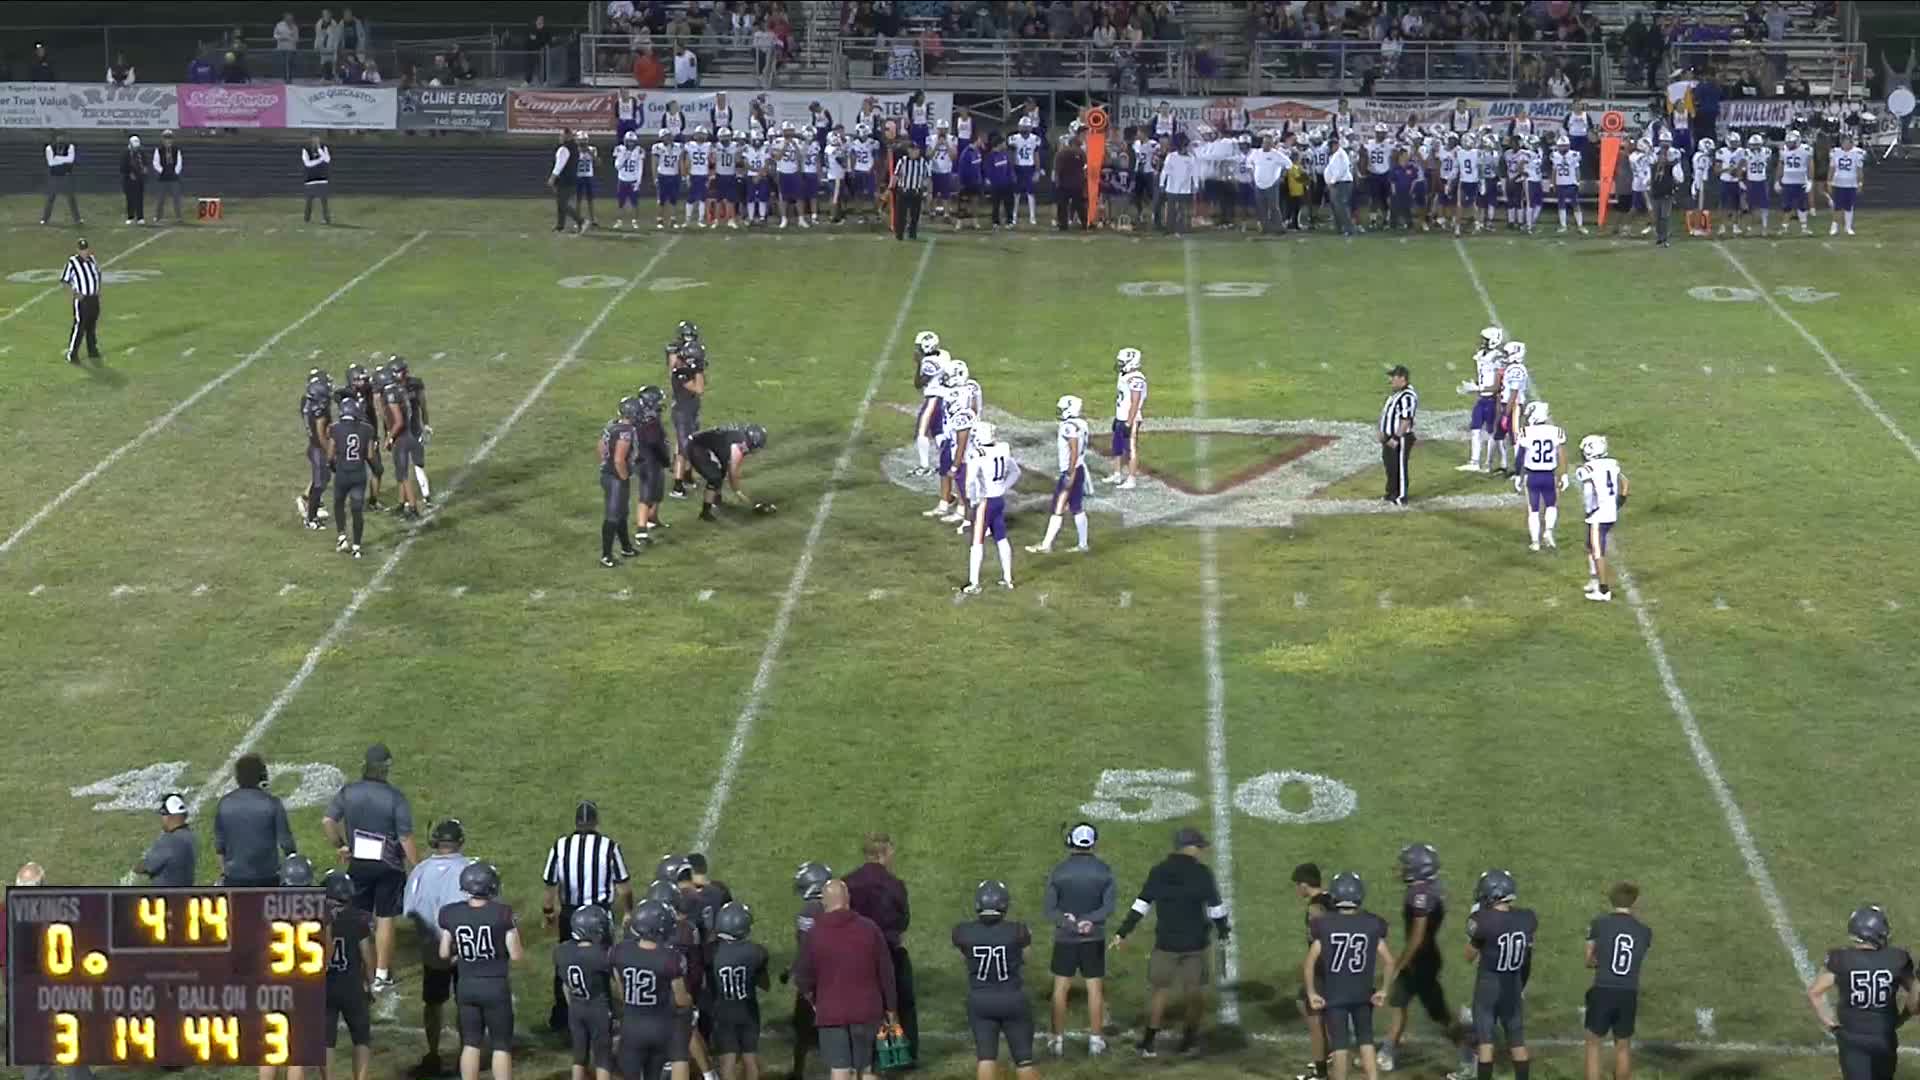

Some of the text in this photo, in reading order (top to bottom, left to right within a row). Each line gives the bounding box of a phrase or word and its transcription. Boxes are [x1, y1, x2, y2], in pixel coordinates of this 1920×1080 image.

[13, 96, 36, 105] True
[39, 95, 69, 106] Value
[421, 91, 505, 106] CLINE ENERGY
[1488, 102, 1524, 116] AUTO
[346, 433, 361, 461] 2
[1531, 439, 1554, 464] 32
[992, 455, 1006, 482] 11
[1079, 768, 1358, 824] 50
[455, 924, 496, 962] 64
[1330, 932, 1369, 973] 73
[1497, 931, 1527, 972] 10
[1611, 933, 1634, 976] 6
[972, 945, 1009, 982] 71
[567, 964, 590, 1000] 9
[623, 966, 657, 1006] 12
[718, 965, 747, 1000] 11
[1850, 969, 1894, 1009] 56
